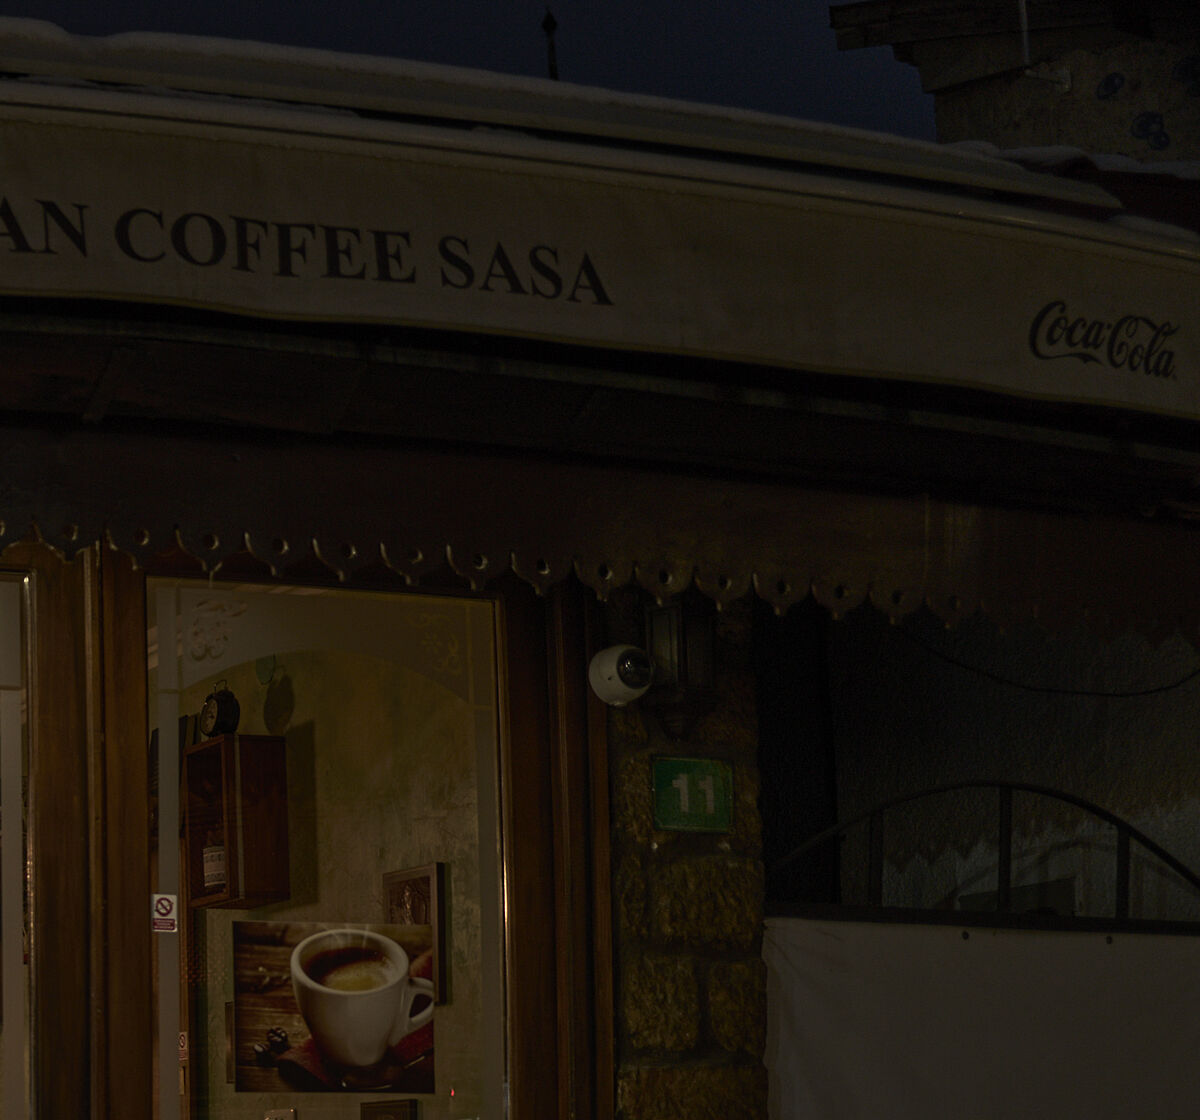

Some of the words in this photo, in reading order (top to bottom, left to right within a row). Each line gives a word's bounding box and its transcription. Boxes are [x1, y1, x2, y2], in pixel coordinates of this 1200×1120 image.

[114, 208, 417, 284] COFFEE
[438, 235, 614, 306] SASA
[1029, 300, 1180, 378] Coca-Cola
[671, 773, 715, 815] 11
